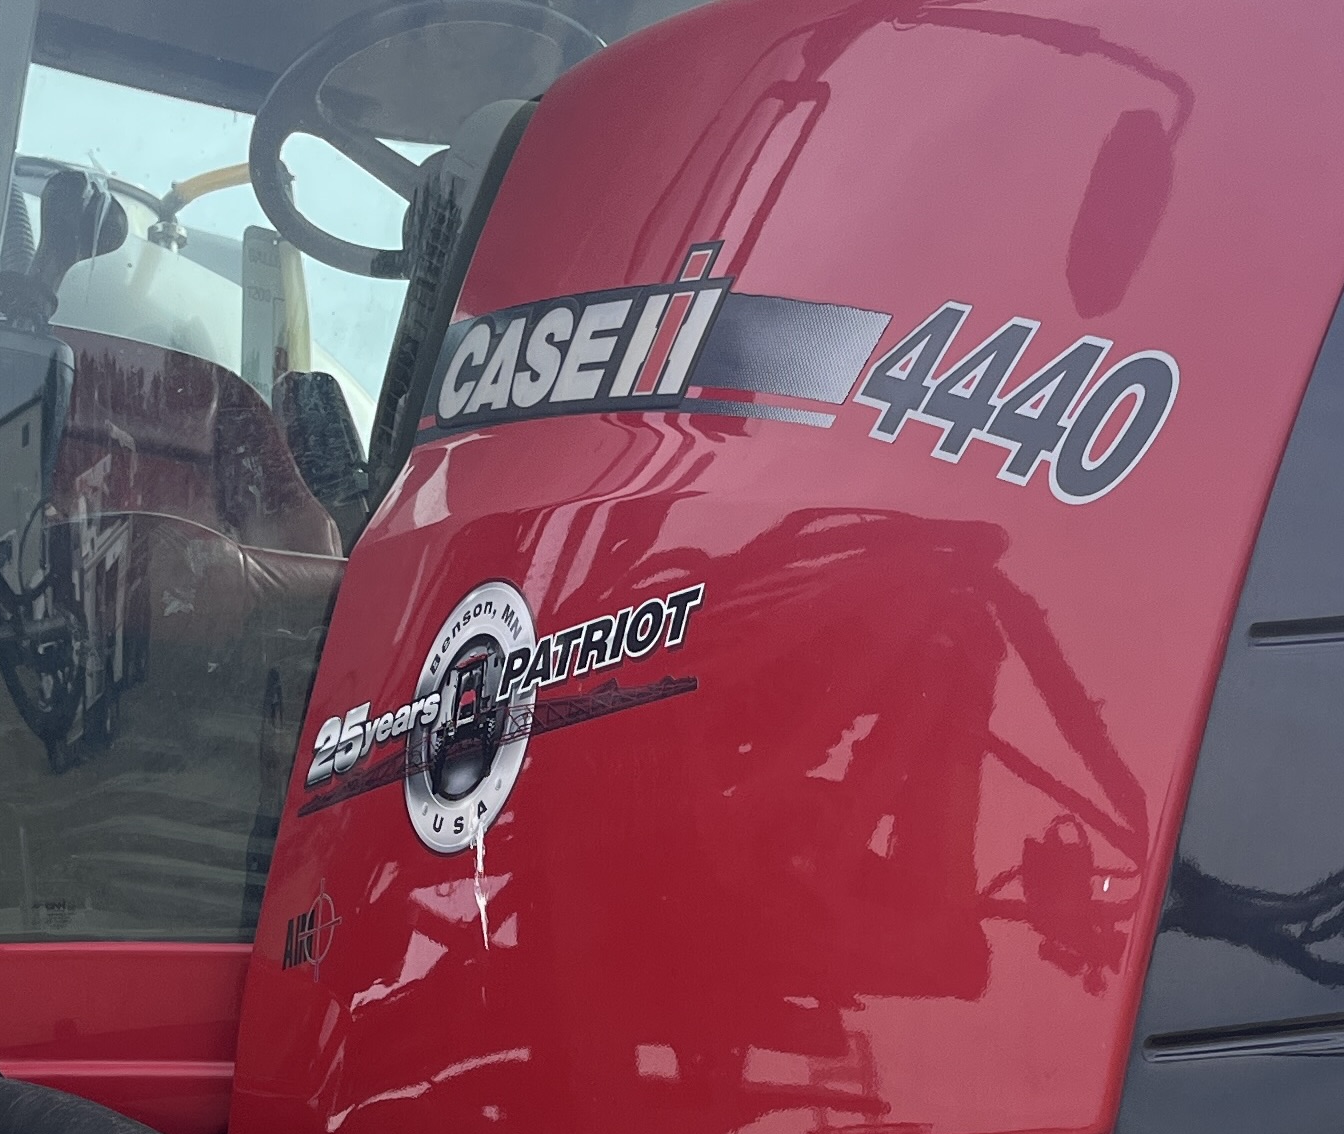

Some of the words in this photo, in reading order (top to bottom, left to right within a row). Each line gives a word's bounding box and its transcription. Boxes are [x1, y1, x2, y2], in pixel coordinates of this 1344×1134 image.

[439, 299, 633, 420] CASE
[853, 301, 1180, 505] 4440
[430, 601, 497, 676] Benson,
[500, 603, 523, 641] MN
[496, 583, 705, 701] PATRIOT
